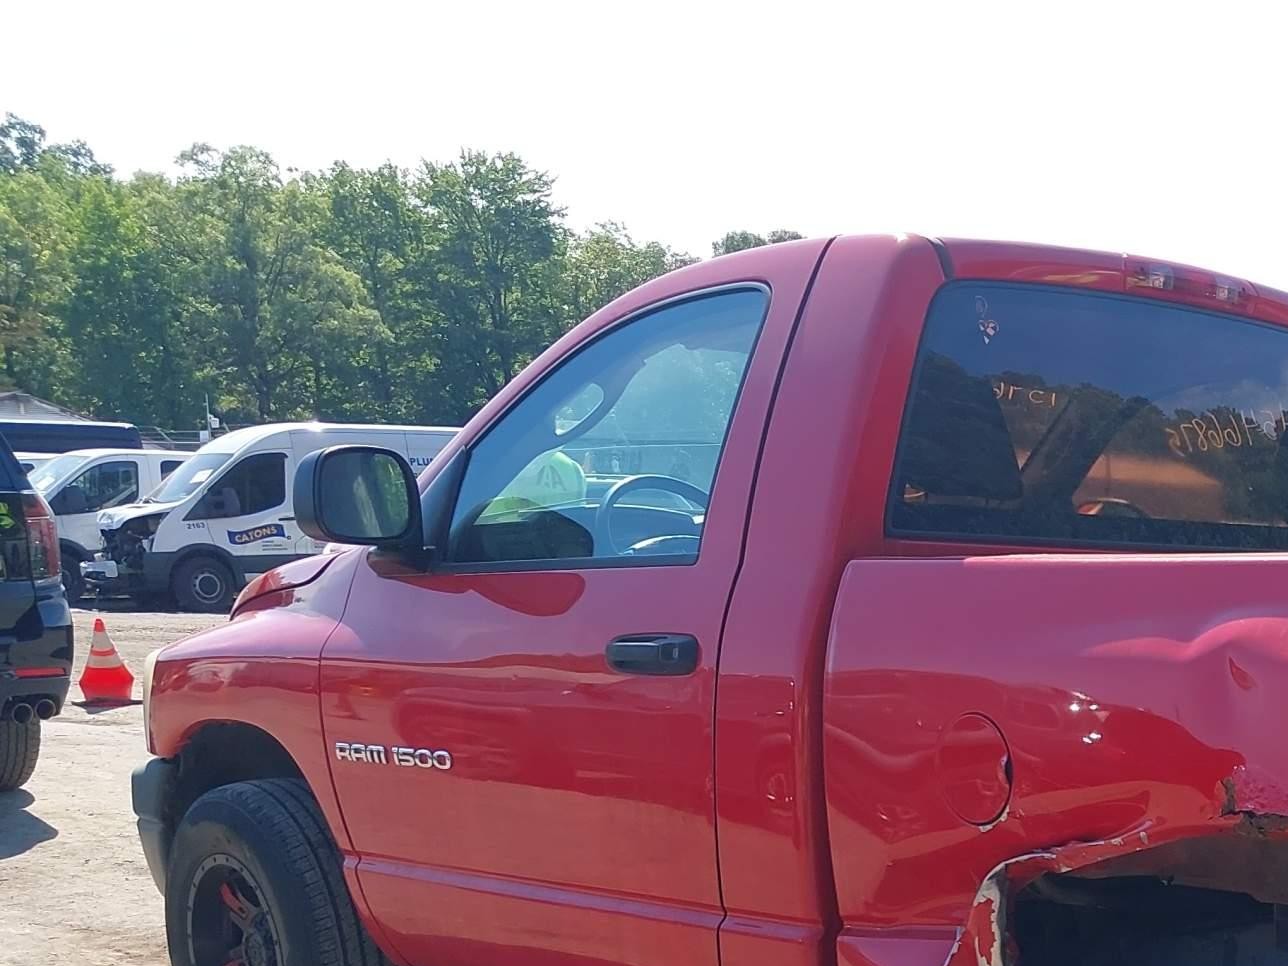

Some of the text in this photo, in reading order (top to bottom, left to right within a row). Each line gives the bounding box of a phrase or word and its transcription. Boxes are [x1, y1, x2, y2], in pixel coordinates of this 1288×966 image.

[234, 526, 278, 543] CATONS
[335, 742, 452, 770] RAM 1500
